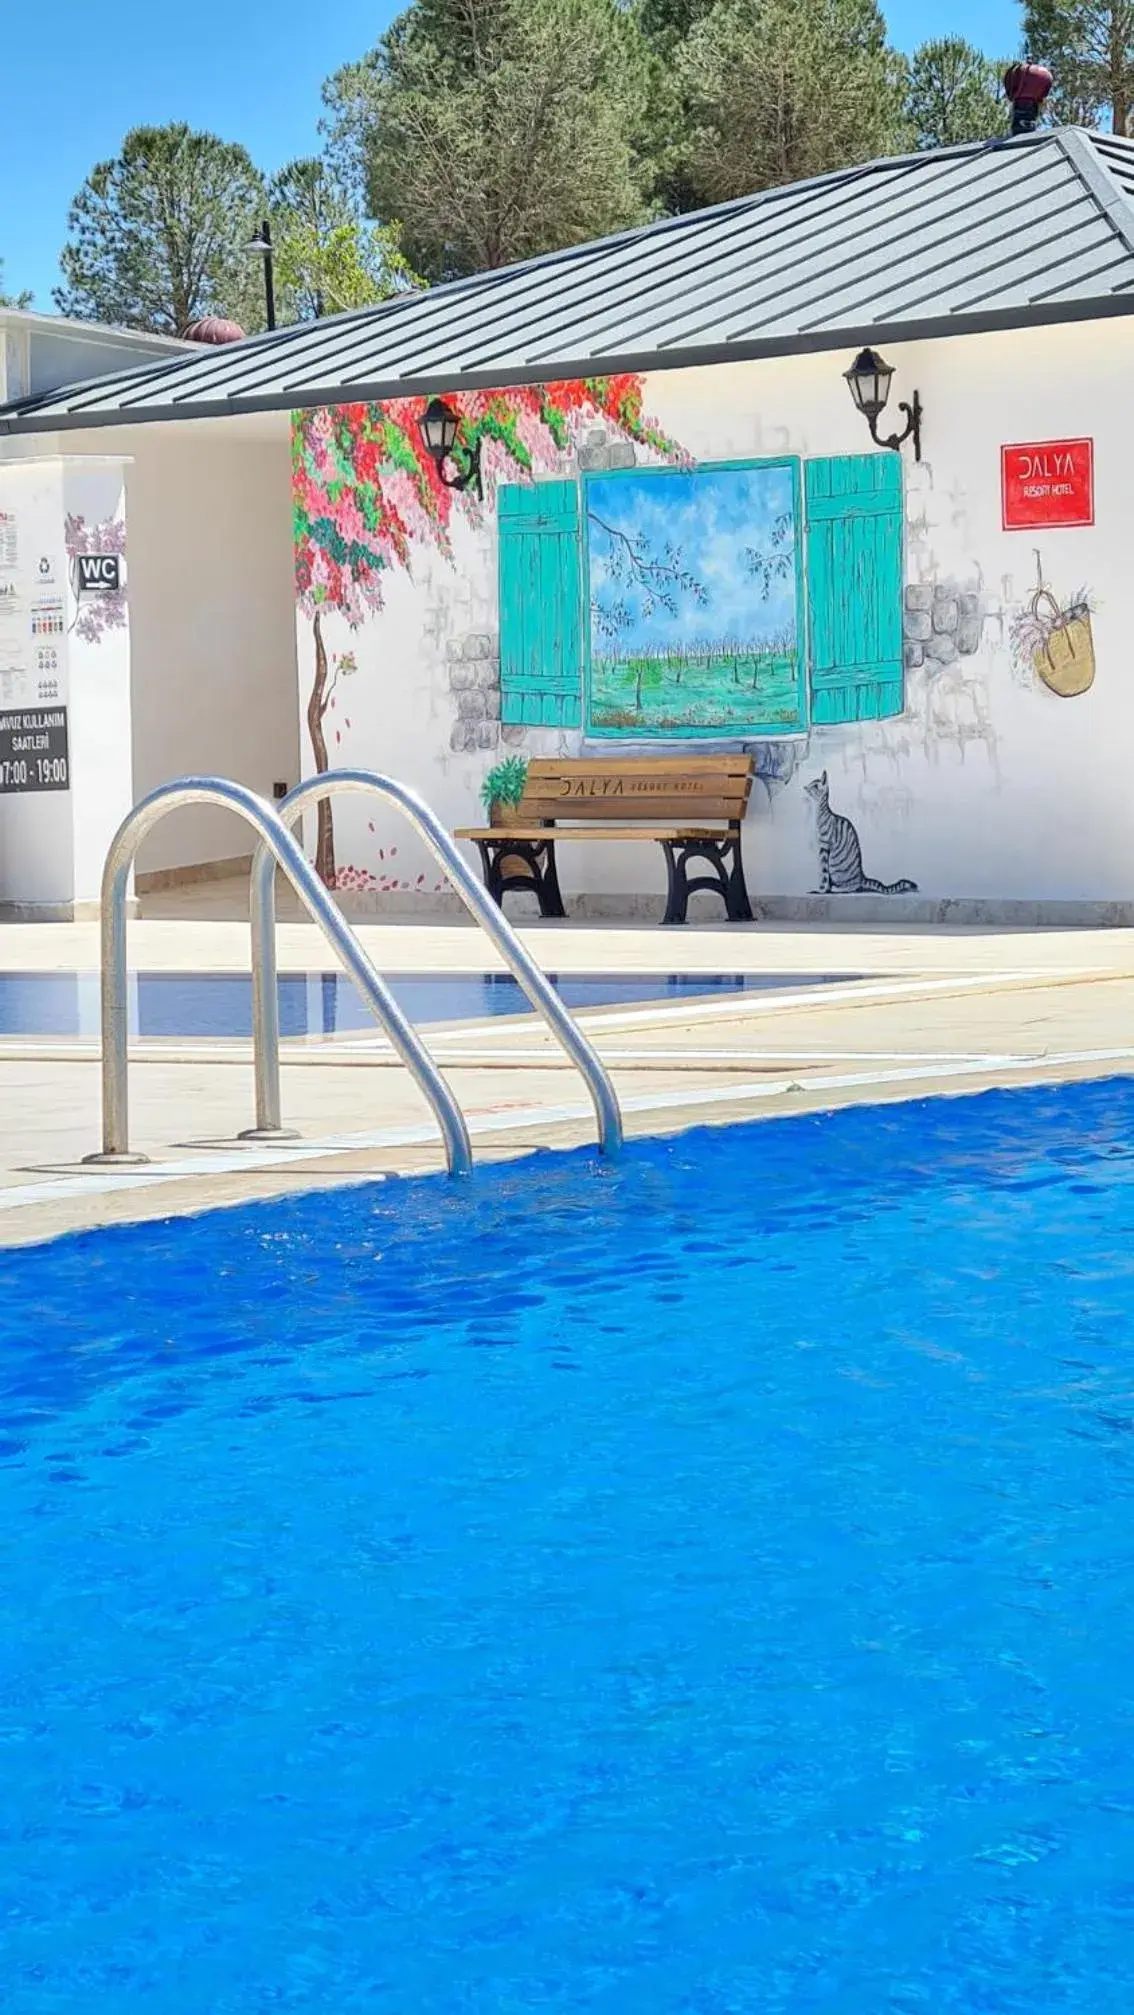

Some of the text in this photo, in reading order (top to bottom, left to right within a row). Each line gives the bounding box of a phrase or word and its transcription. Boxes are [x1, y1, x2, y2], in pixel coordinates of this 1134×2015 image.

[1018, 453, 1075, 479] DALYA
[1051, 483, 1075, 496] HOTEL
[81, 558, 116, 579] WC
[22, 712, 64, 729] KULLANIM
[12, 731, 49, 751] SAATLERİ
[36, 758, 67, 783] 19:00
